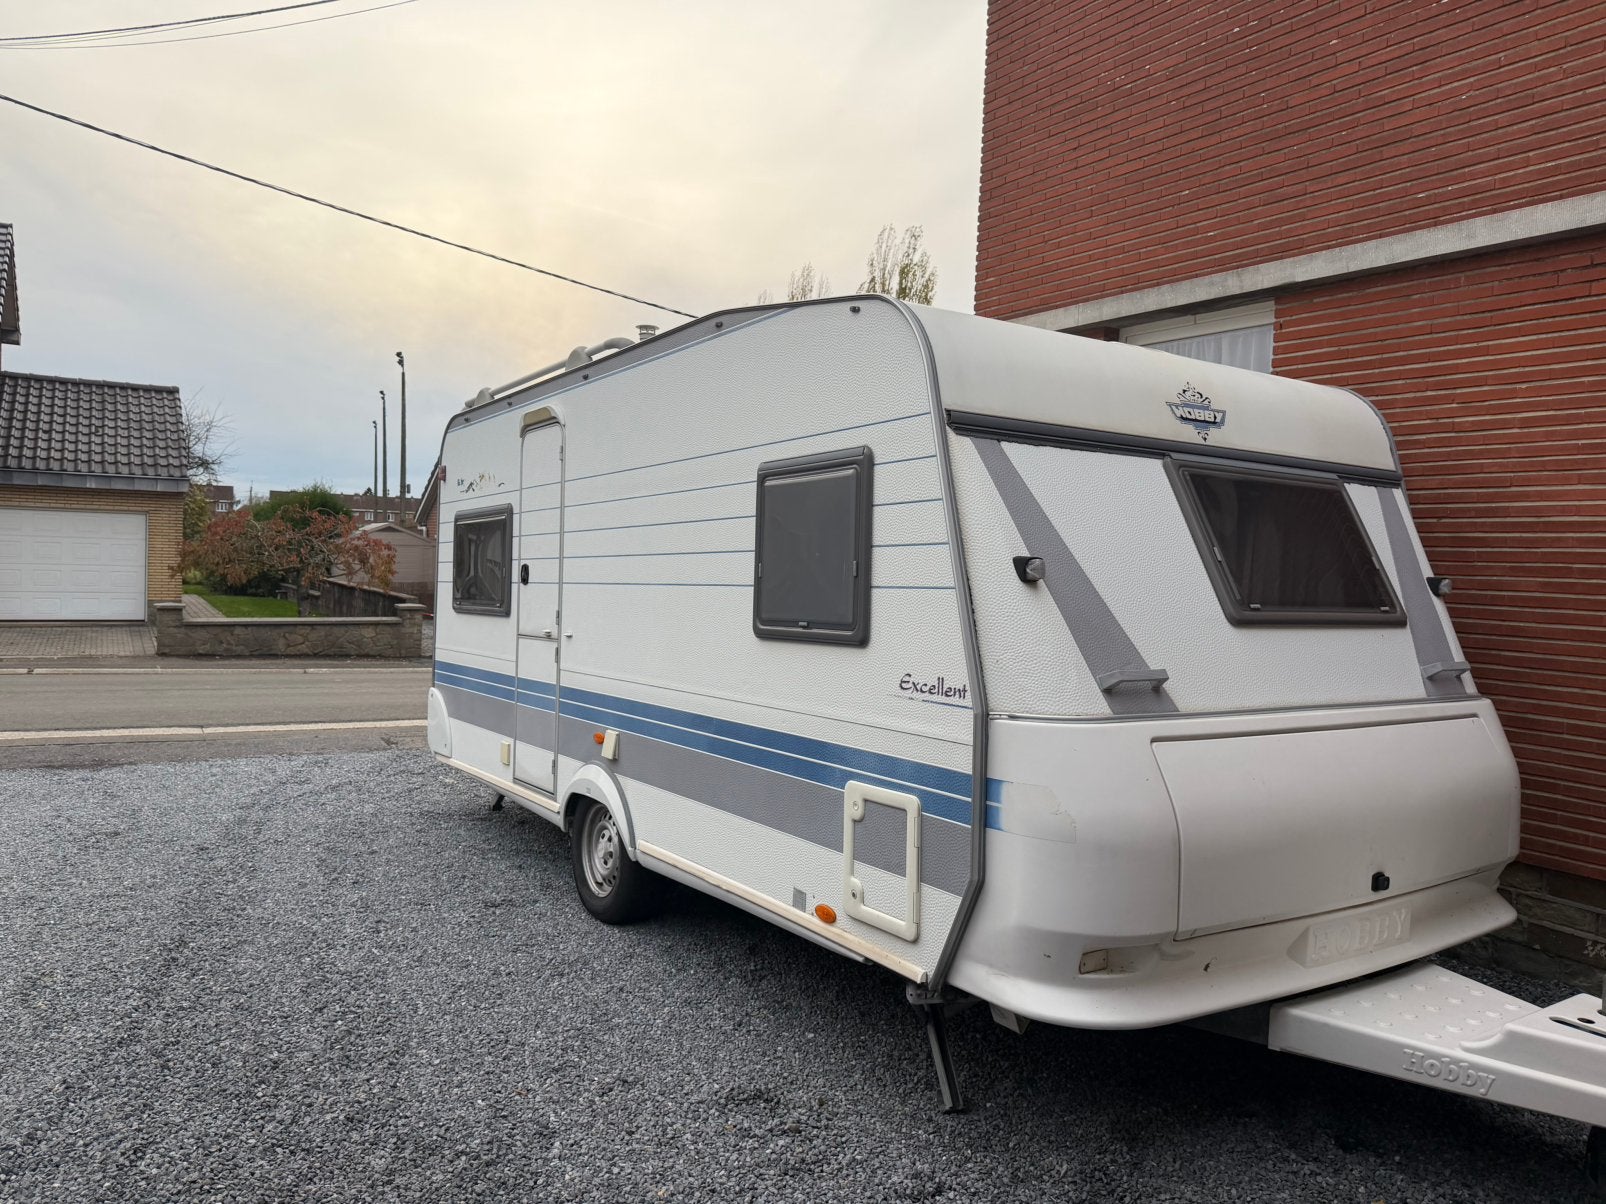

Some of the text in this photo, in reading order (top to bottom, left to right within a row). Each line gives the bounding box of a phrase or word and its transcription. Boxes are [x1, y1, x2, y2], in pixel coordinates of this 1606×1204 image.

[899, 673, 968, 700] Excellent
[1310, 907, 1406, 960] HOBBY
[1402, 1048, 1496, 1096] Hobby
